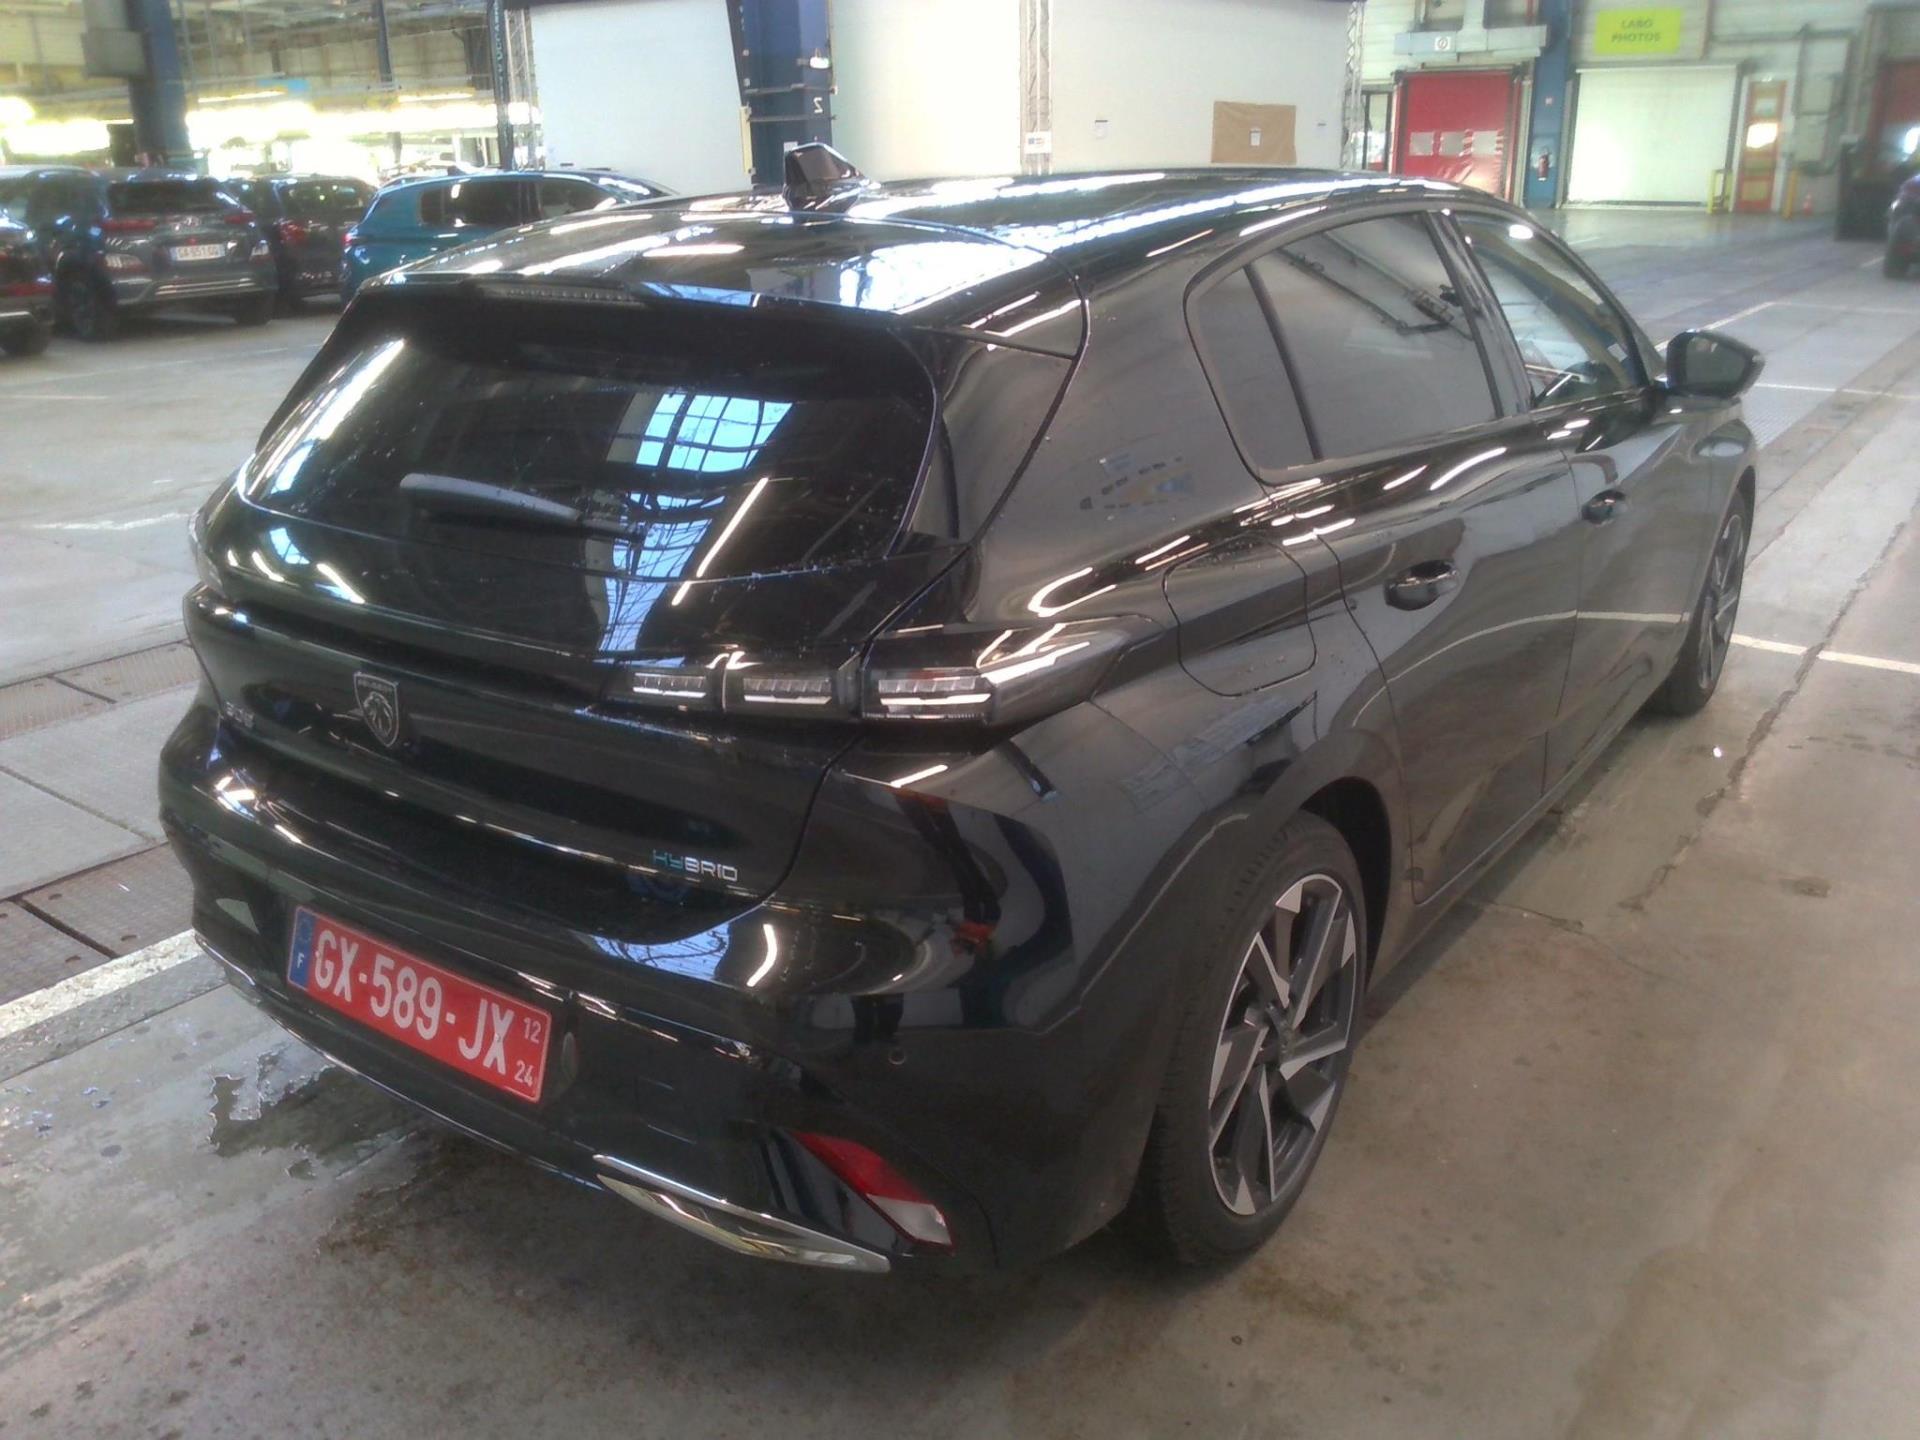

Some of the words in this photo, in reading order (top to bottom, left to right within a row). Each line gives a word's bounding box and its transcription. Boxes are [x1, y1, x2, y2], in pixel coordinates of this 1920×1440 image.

[1621, 17, 1654, 30] LABO
[1611, 31, 1662, 43] PHOTOS
[296, 953, 305, 968] F
[523, 1017, 542, 1044] 12
[514, 1060, 534, 1087] 24
